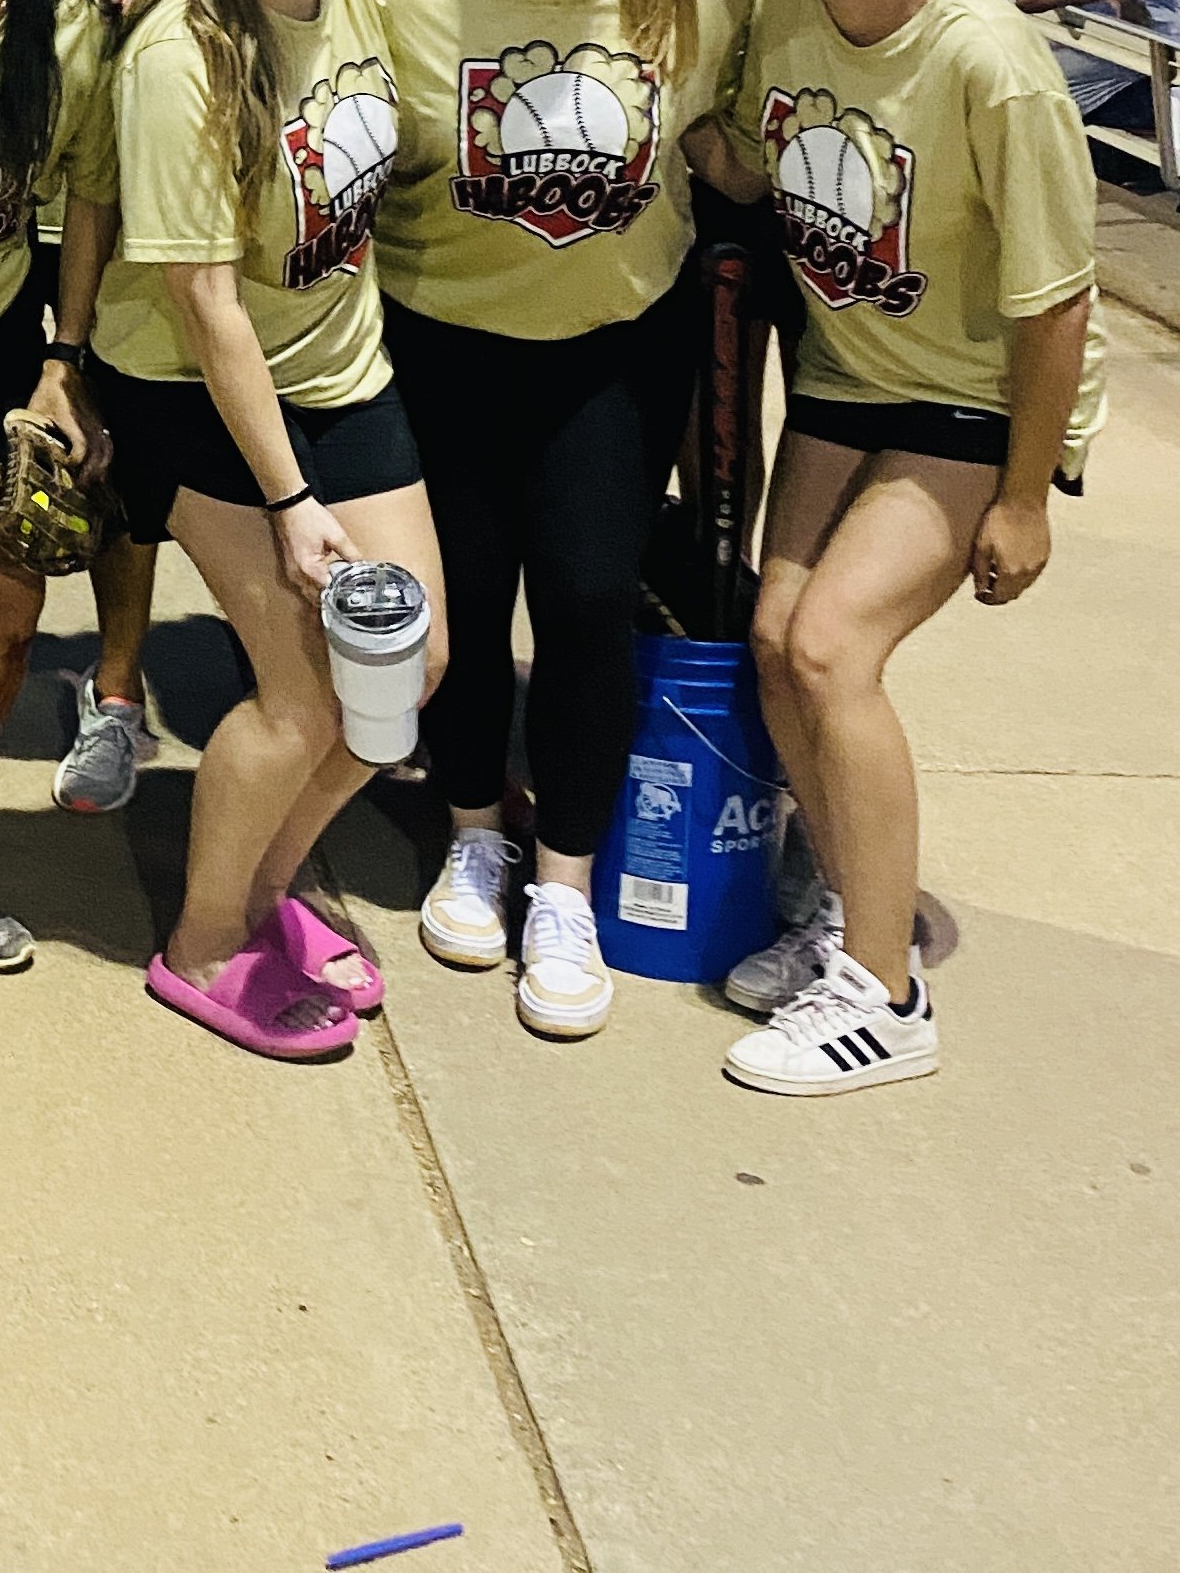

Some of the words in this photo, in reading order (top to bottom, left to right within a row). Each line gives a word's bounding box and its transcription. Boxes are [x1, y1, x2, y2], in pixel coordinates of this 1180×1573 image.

[509, 153, 624, 180] LUBBOCK
[452, 173, 660, 233] HABOOBS
[785, 196, 870, 252] LUBBOCK
